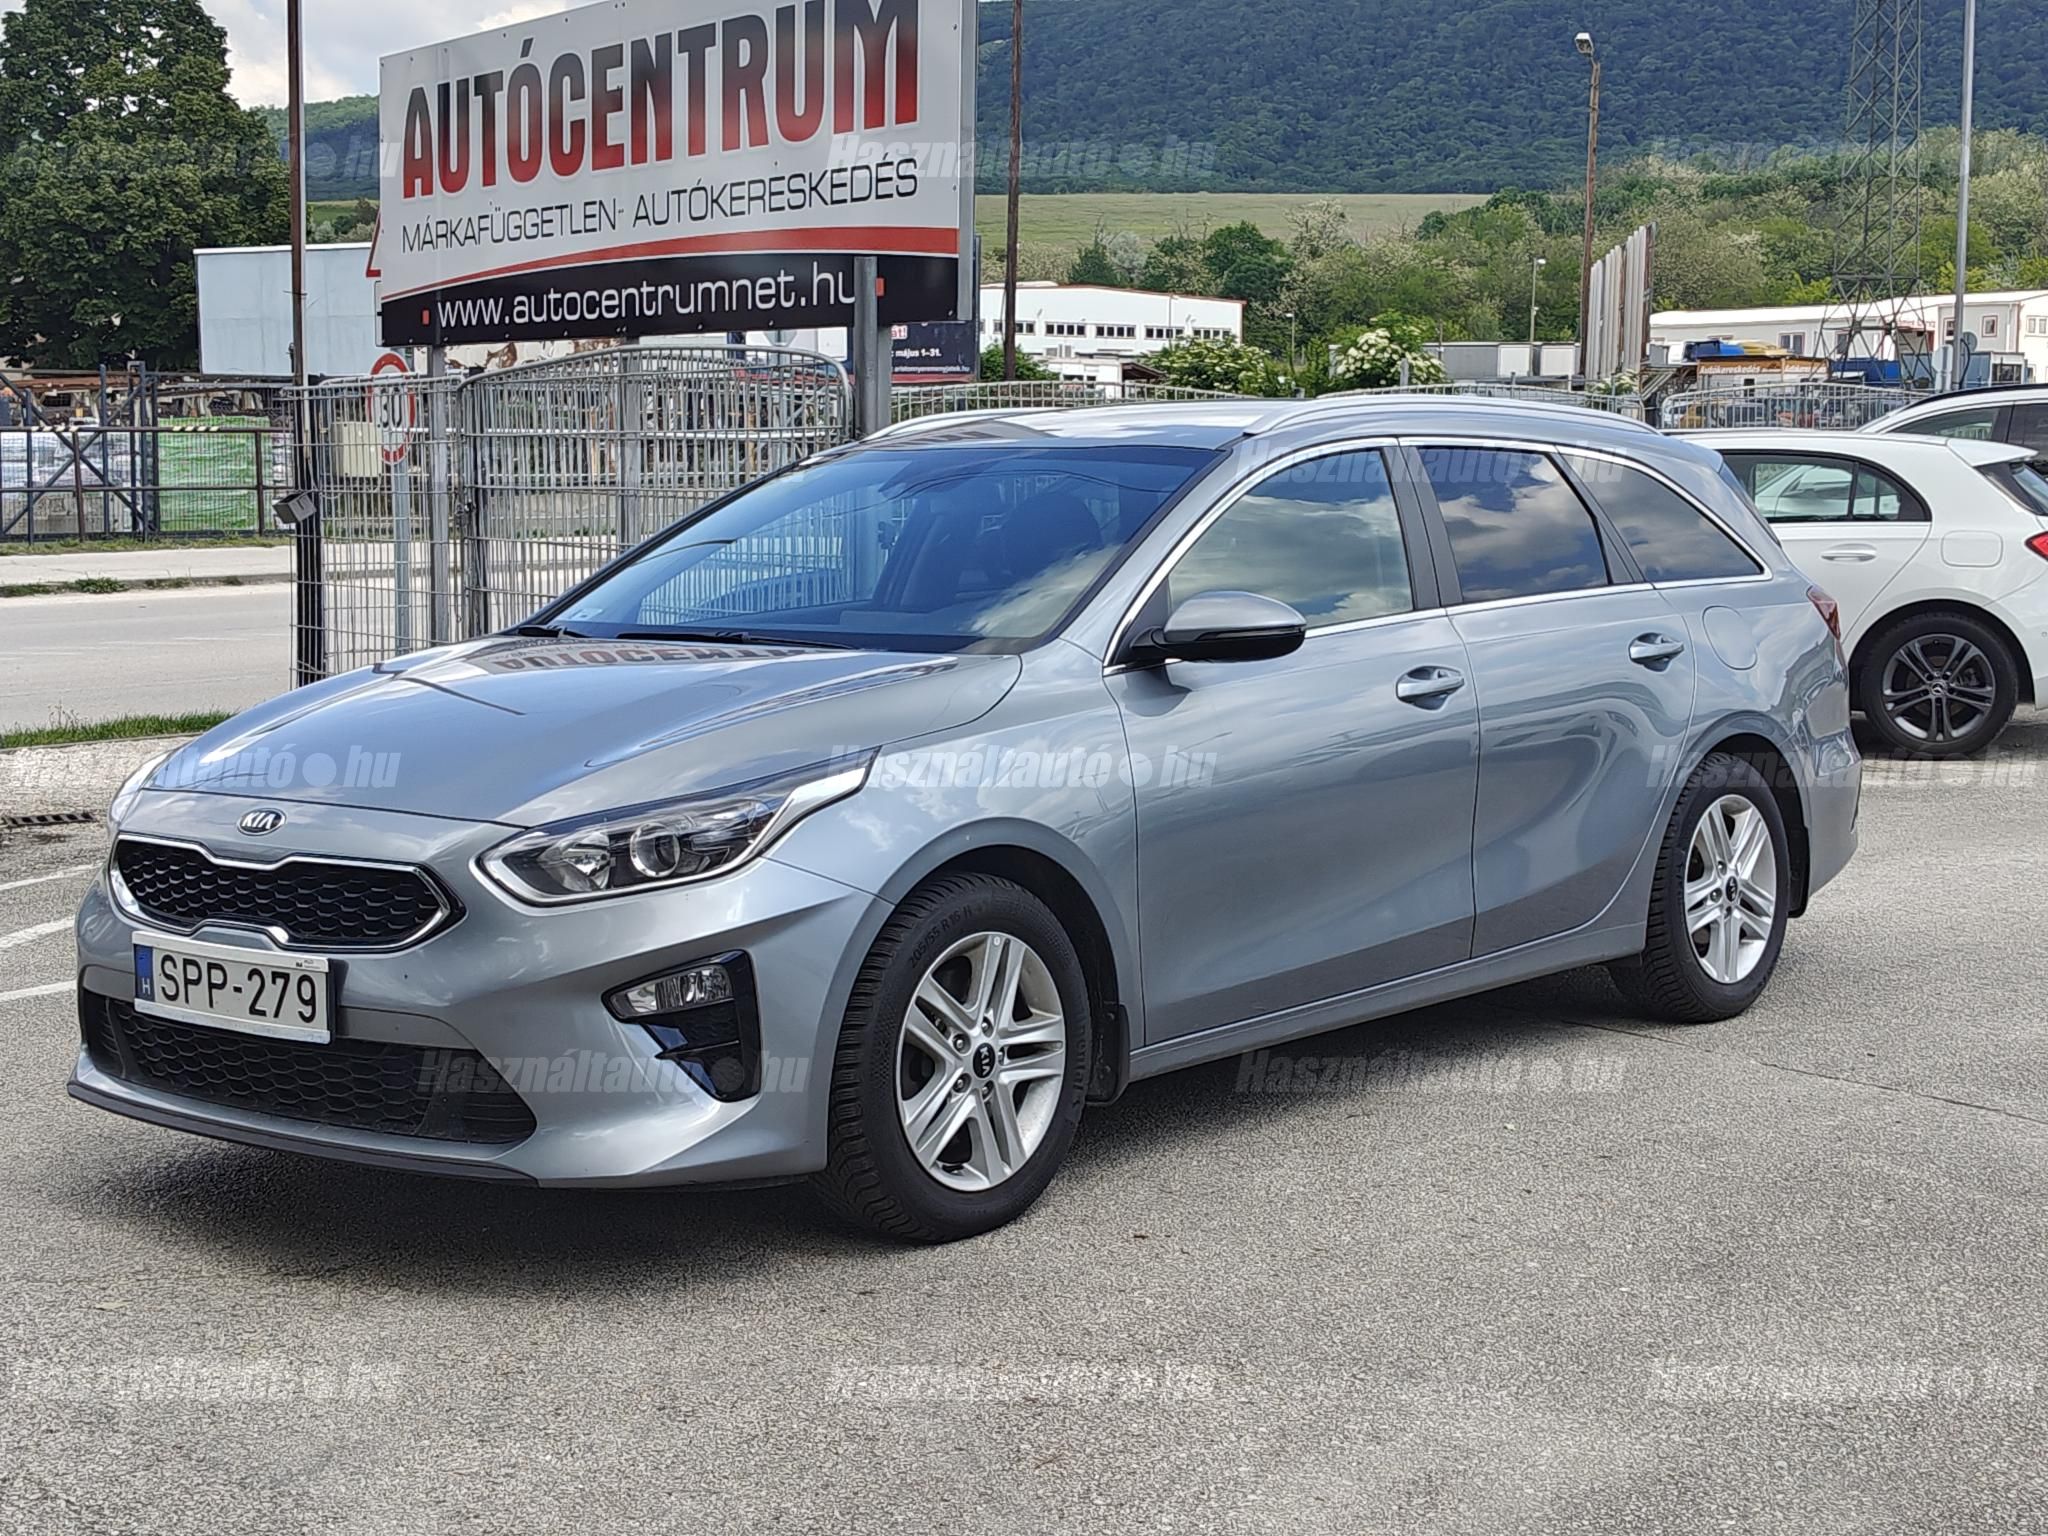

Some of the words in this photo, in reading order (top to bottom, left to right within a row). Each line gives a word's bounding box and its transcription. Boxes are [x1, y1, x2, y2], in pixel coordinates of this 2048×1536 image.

[402, 0, 919, 199] AUTÓCENTRUM
[632, 153, 918, 228] AUTÓKERESKEDÉS
[438, 262, 856, 328] www.autocentrumnet.hu
[241, 812, 275, 829] KIA
[142, 978, 151, 995] H
[161, 954, 316, 1023] SPP-279
[980, 1046, 991, 1076] KIA
